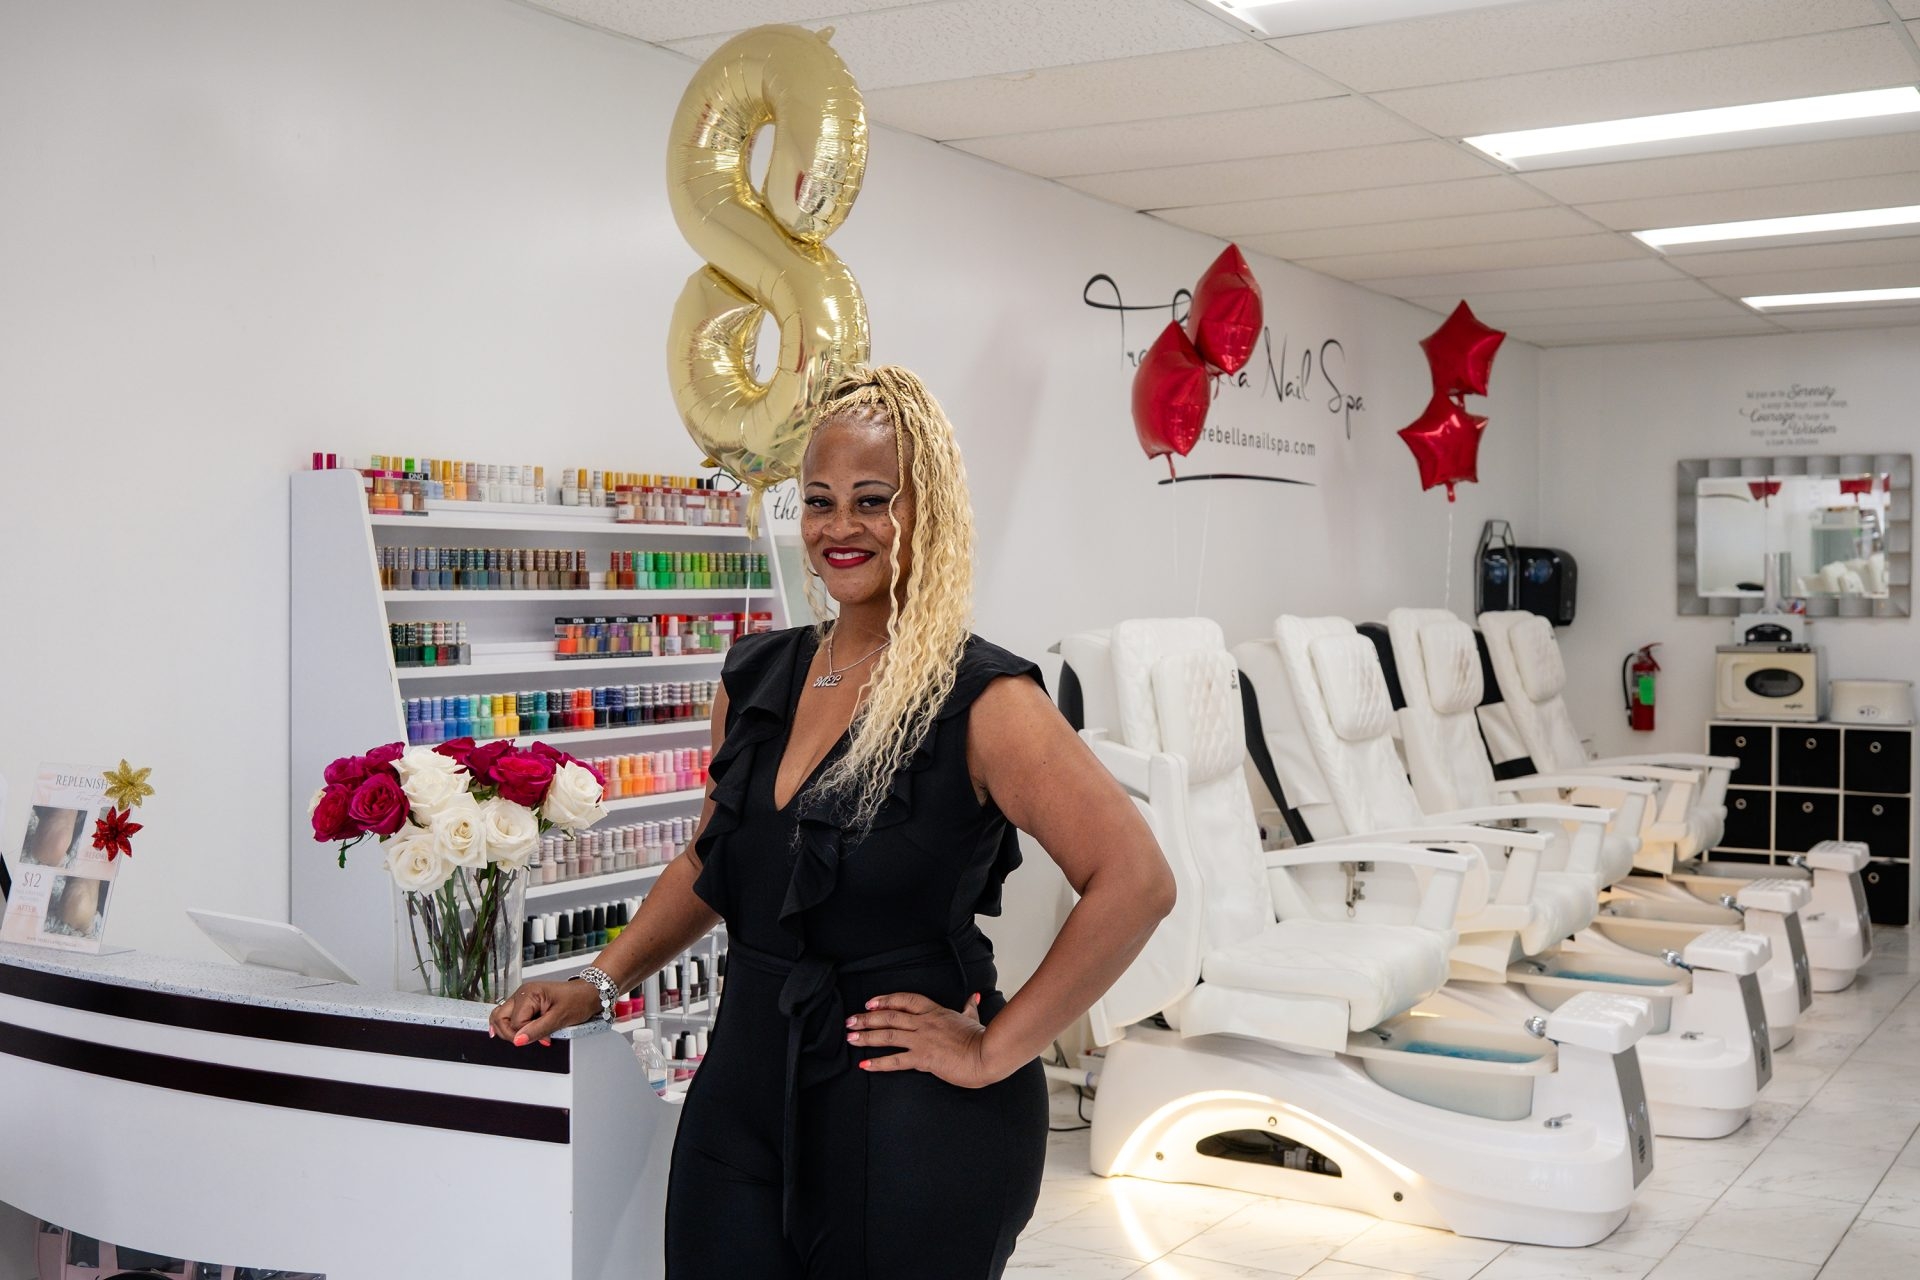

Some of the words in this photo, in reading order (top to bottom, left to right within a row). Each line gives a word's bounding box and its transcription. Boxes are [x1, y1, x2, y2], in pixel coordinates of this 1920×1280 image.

[1261, 326, 1310, 402] Nail
[1320, 339, 1366, 440] Spa
[1200, 424, 1316, 456] rebellanailspa.com
[773, 487, 798, 520] the
[55, 774, 108, 790] REPLENISH
[22, 871, 42, 888] $12
